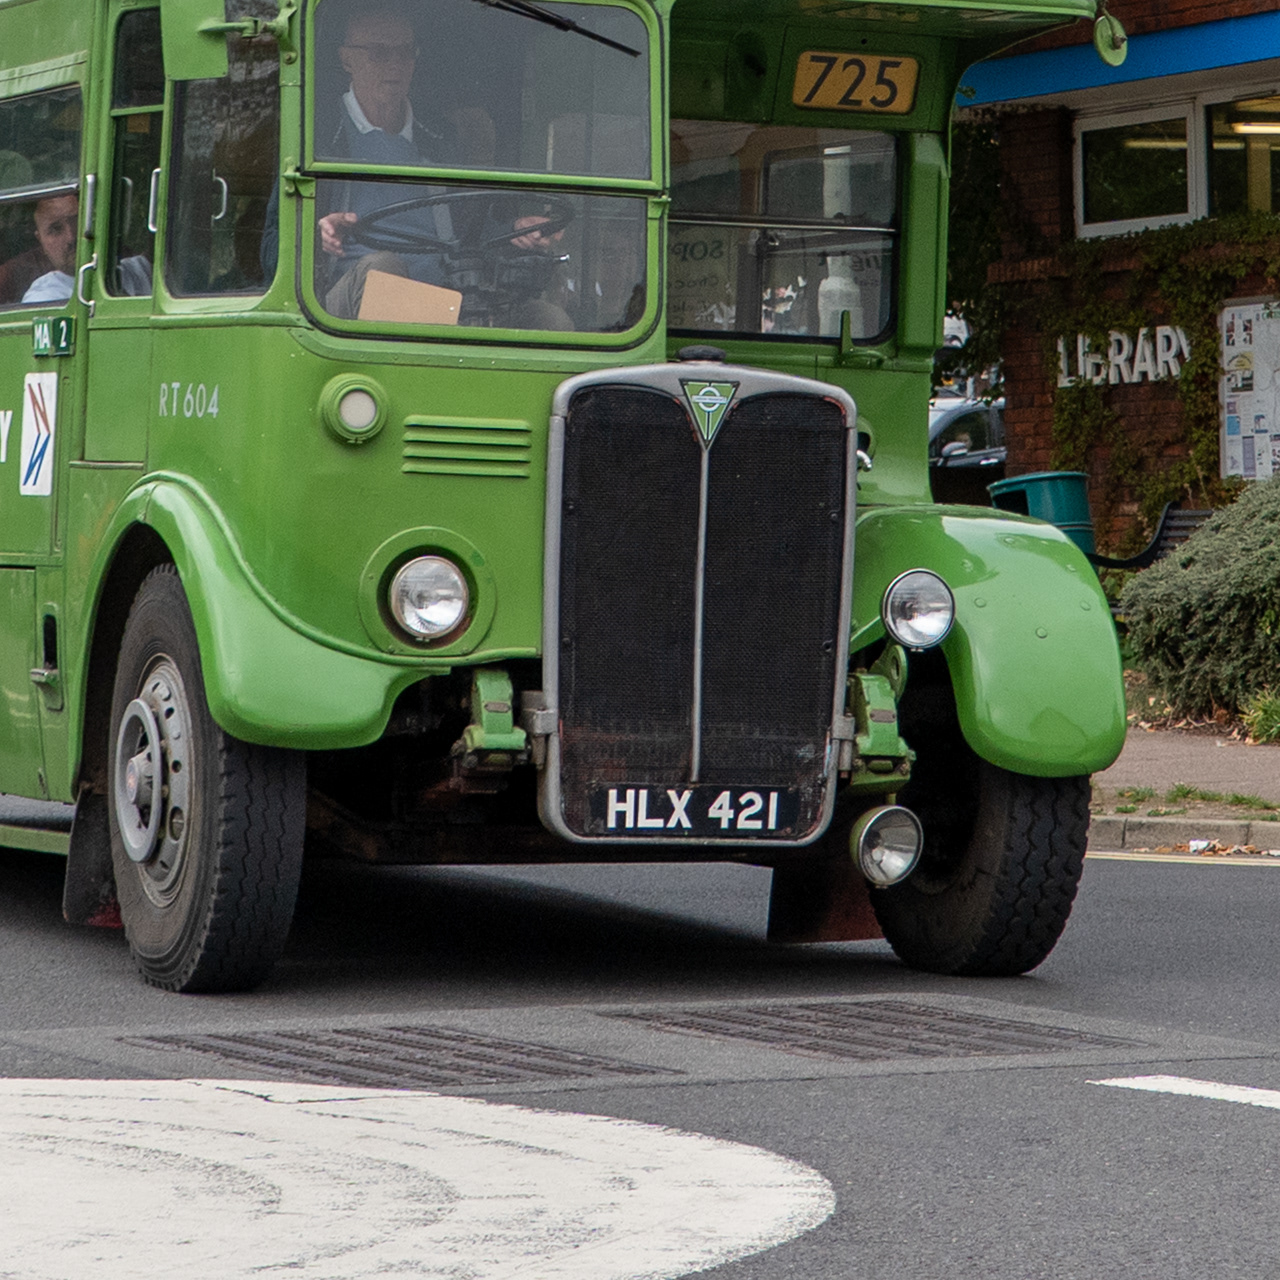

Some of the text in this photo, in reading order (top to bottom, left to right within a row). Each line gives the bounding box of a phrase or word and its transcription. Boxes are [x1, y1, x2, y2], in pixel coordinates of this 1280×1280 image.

[802, 54, 902, 108] 725
[34, 320, 68, 350] MA 2
[606, 787, 779, 830] HLX 421
